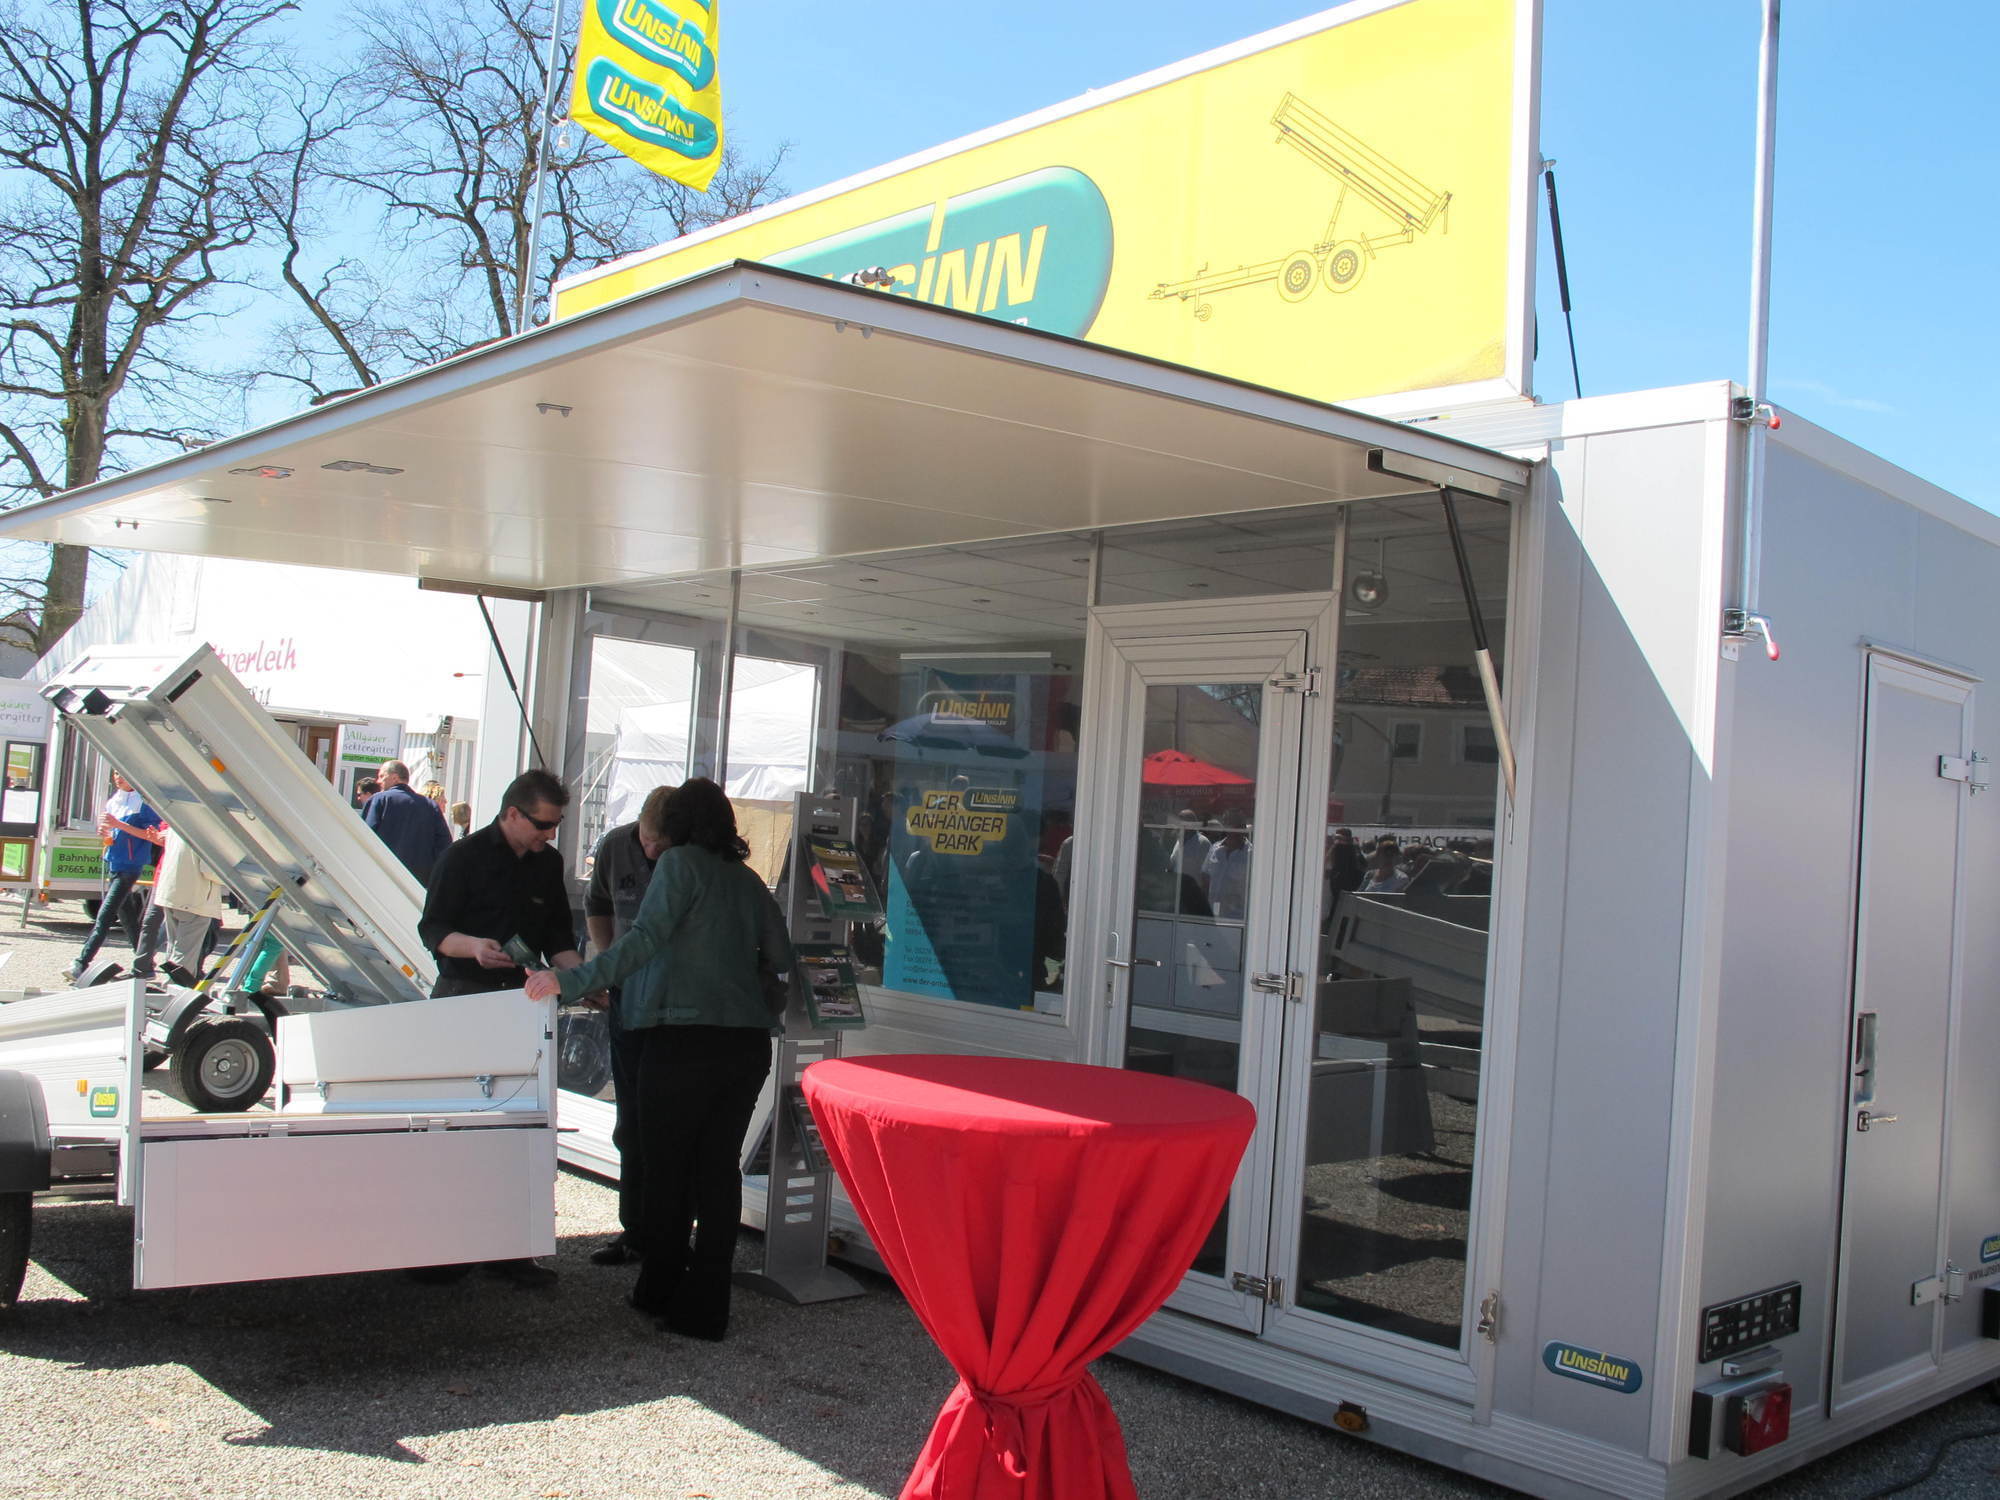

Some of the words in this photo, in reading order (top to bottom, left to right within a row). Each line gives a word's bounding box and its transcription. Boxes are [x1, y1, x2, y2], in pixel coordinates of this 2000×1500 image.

[925, 794, 960, 811] DER
[910, 812, 1004, 833] ANHÄNGER
[935, 833, 981, 851] PARK
